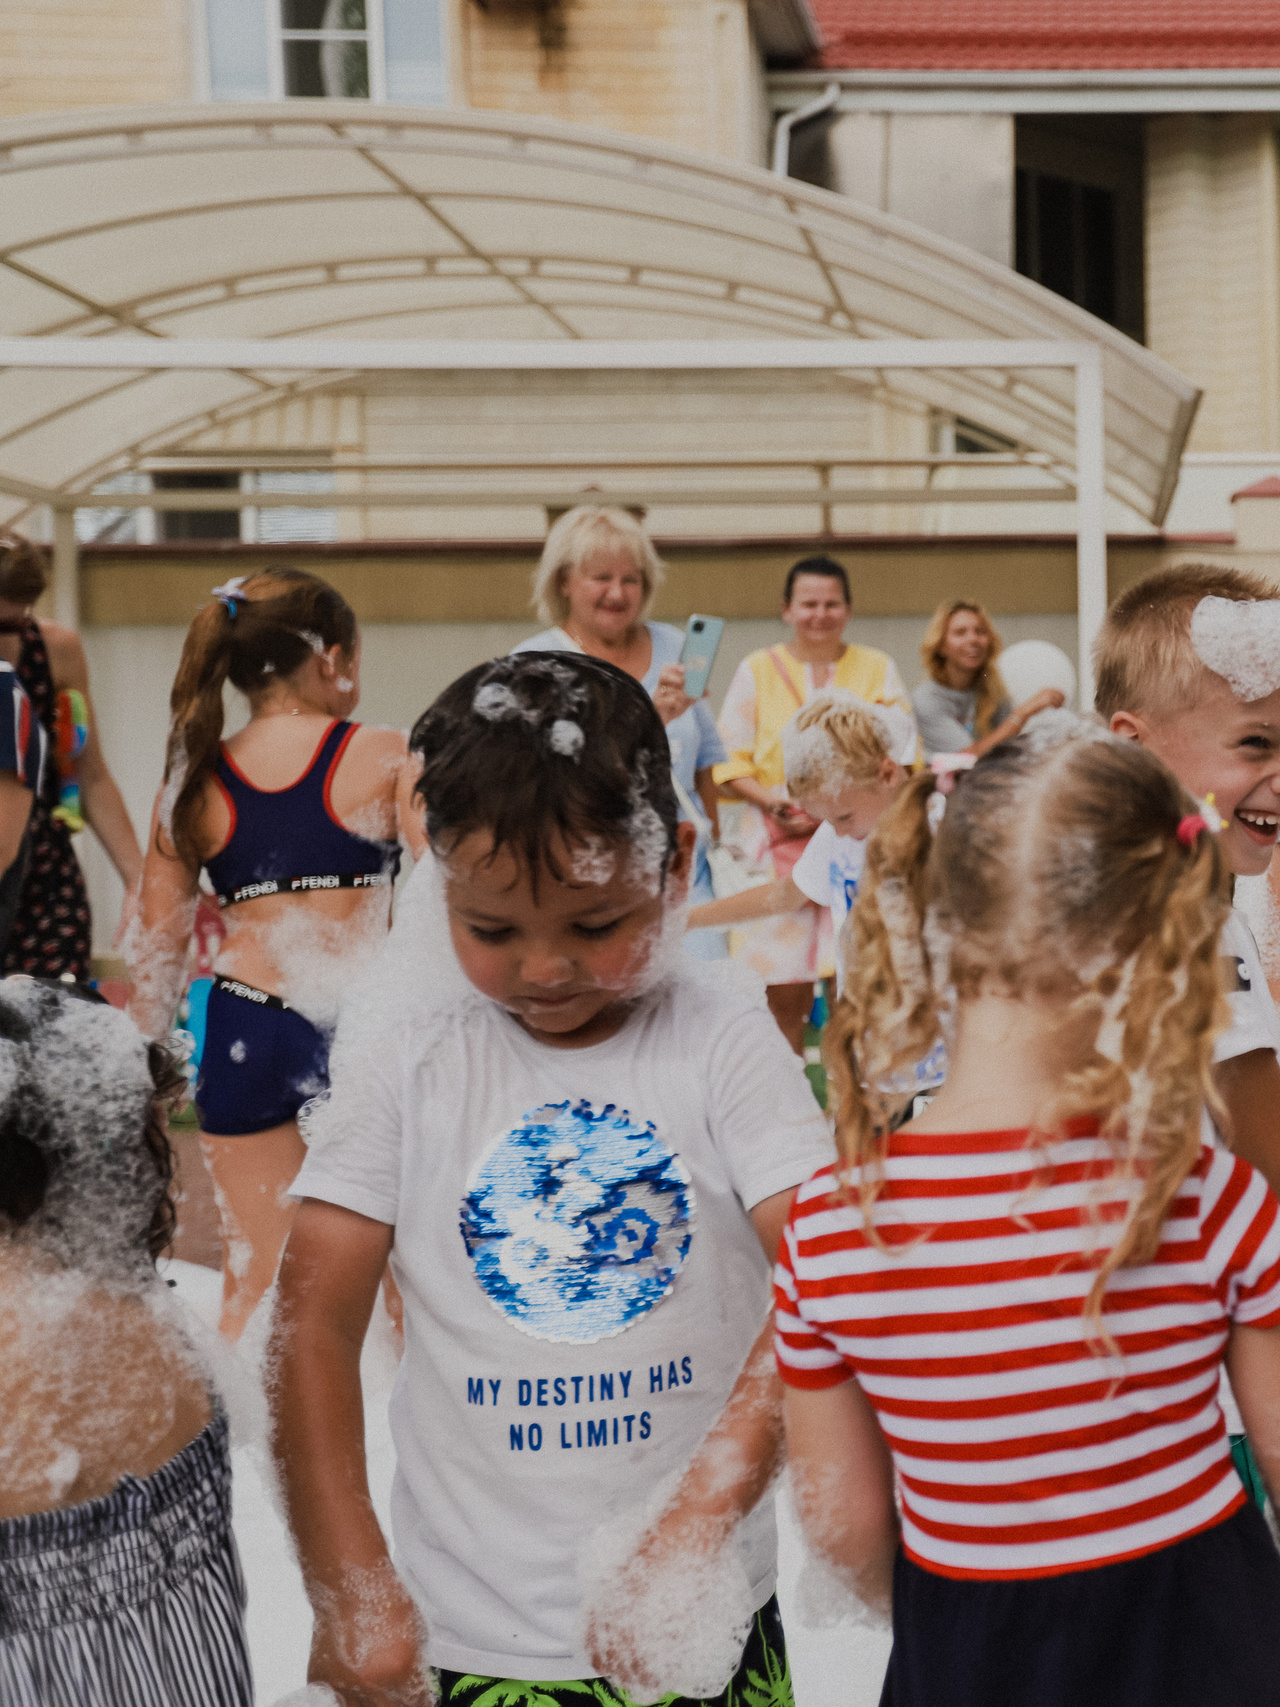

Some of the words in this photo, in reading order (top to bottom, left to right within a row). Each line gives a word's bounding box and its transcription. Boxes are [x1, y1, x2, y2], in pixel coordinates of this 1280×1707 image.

[467, 1377, 501, 1405] MY
[518, 1370, 632, 1406] DESTINY
[650, 1356, 693, 1393] HAS
[510, 1423, 542, 1451] NO
[560, 1411, 651, 1449] LIMITS
